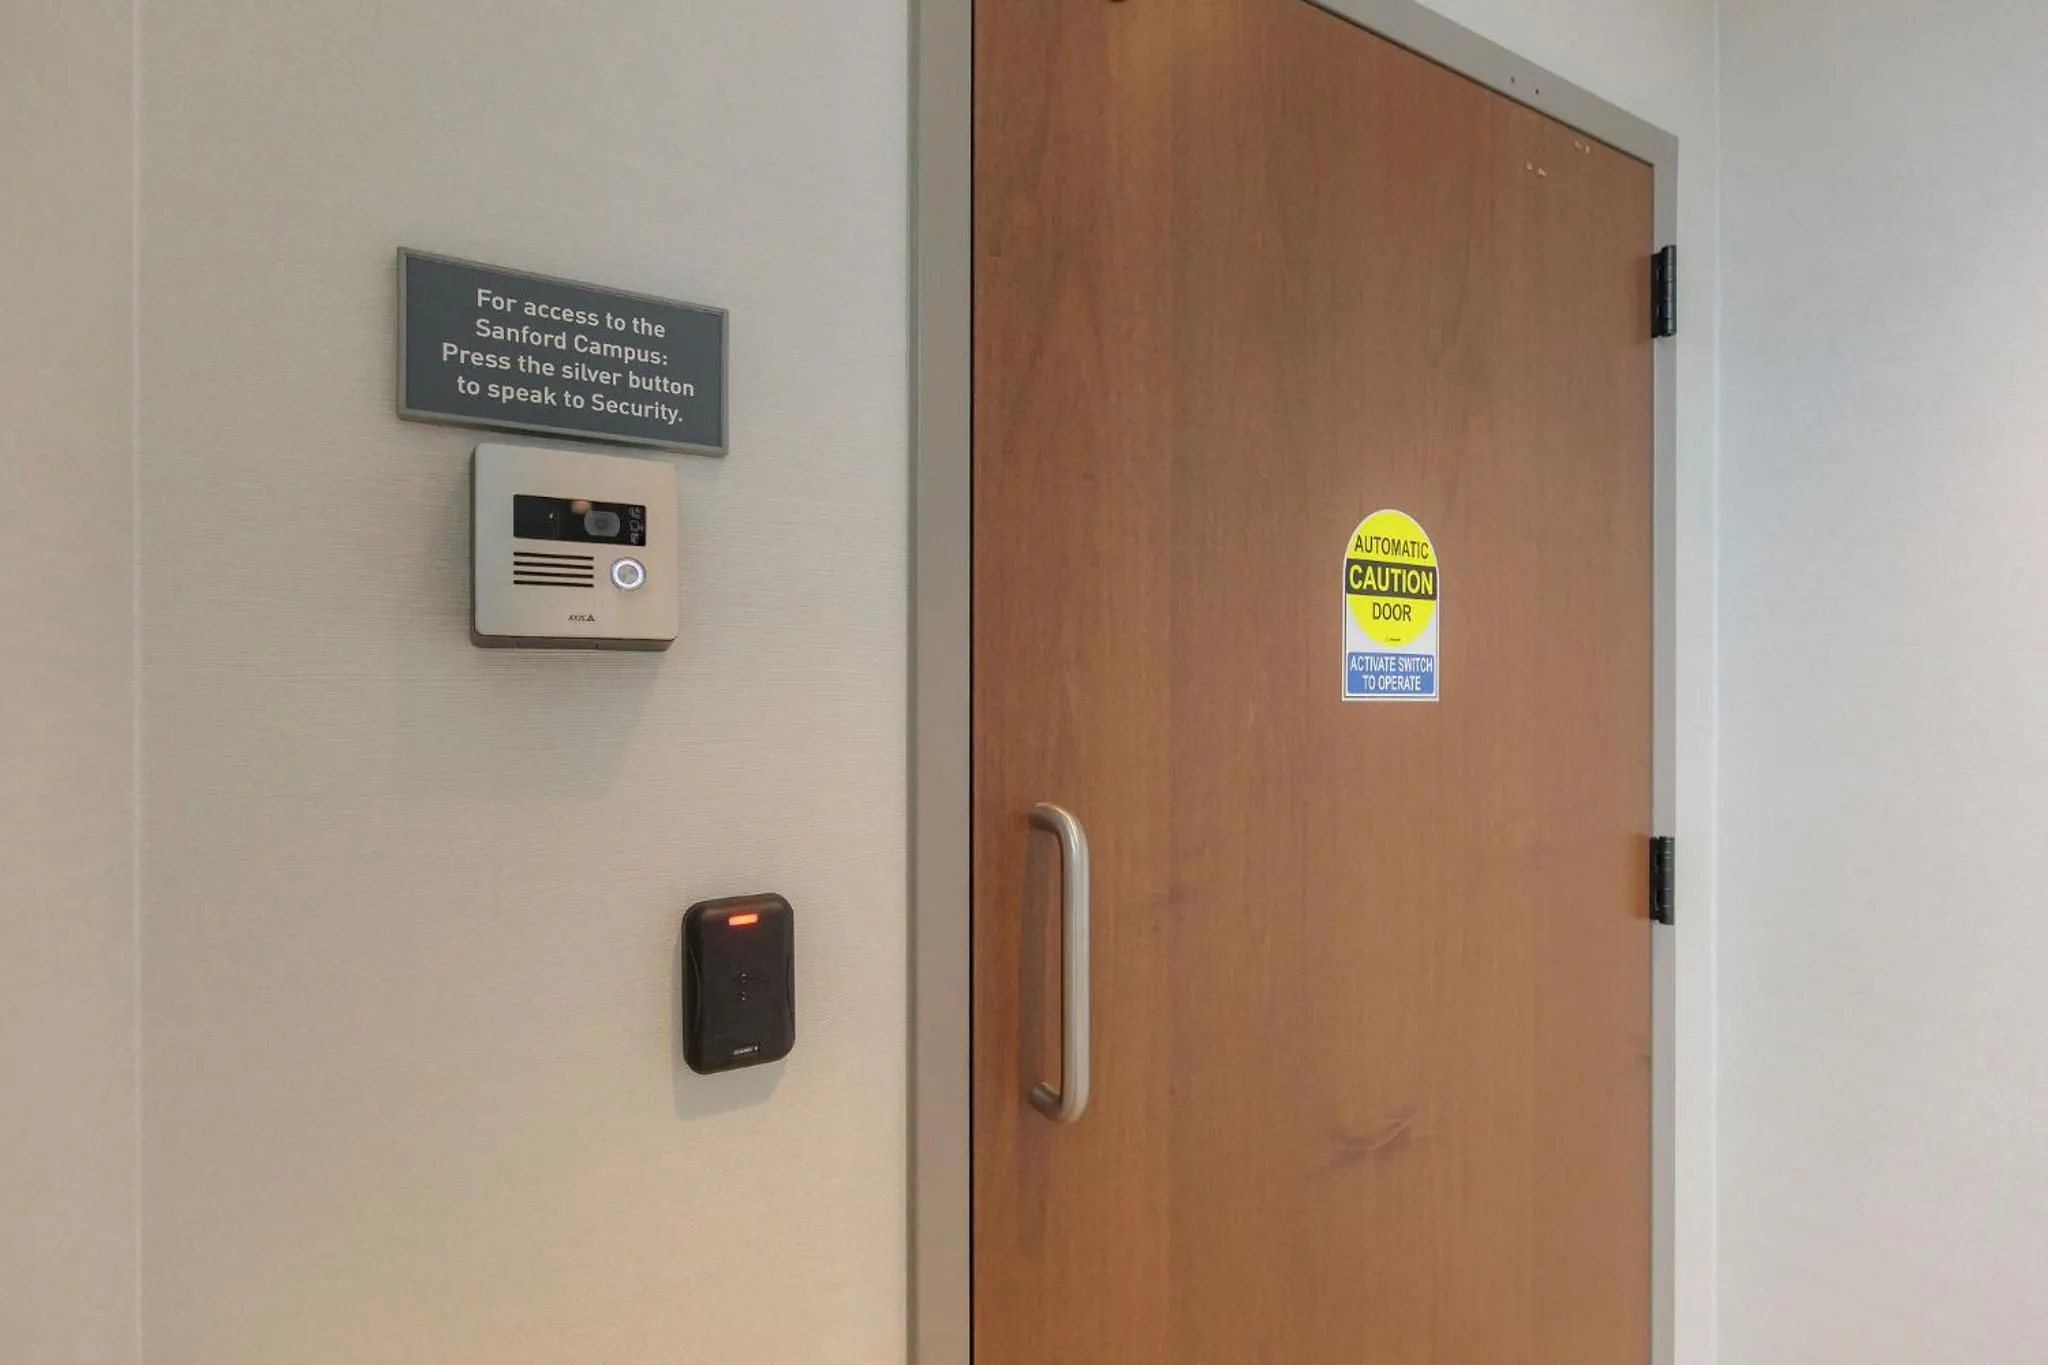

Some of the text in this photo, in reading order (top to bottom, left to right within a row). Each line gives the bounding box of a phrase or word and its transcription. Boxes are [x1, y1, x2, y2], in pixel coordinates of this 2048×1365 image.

[477, 289, 666, 338] For access to the
[476, 319, 668, 366] Sanford Campus:
[442, 343, 695, 397] Press the silver button
[457, 376, 683, 425] to speak to Security.
[1354, 535, 1428, 559] AUTOMATIC
[1349, 564, 1433, 595] CAUTION
[1373, 602, 1411, 621] DOOR
[1350, 656, 1432, 672] ACTIVATE SWITCH
[1362, 675, 1421, 691] TO OPERATE
